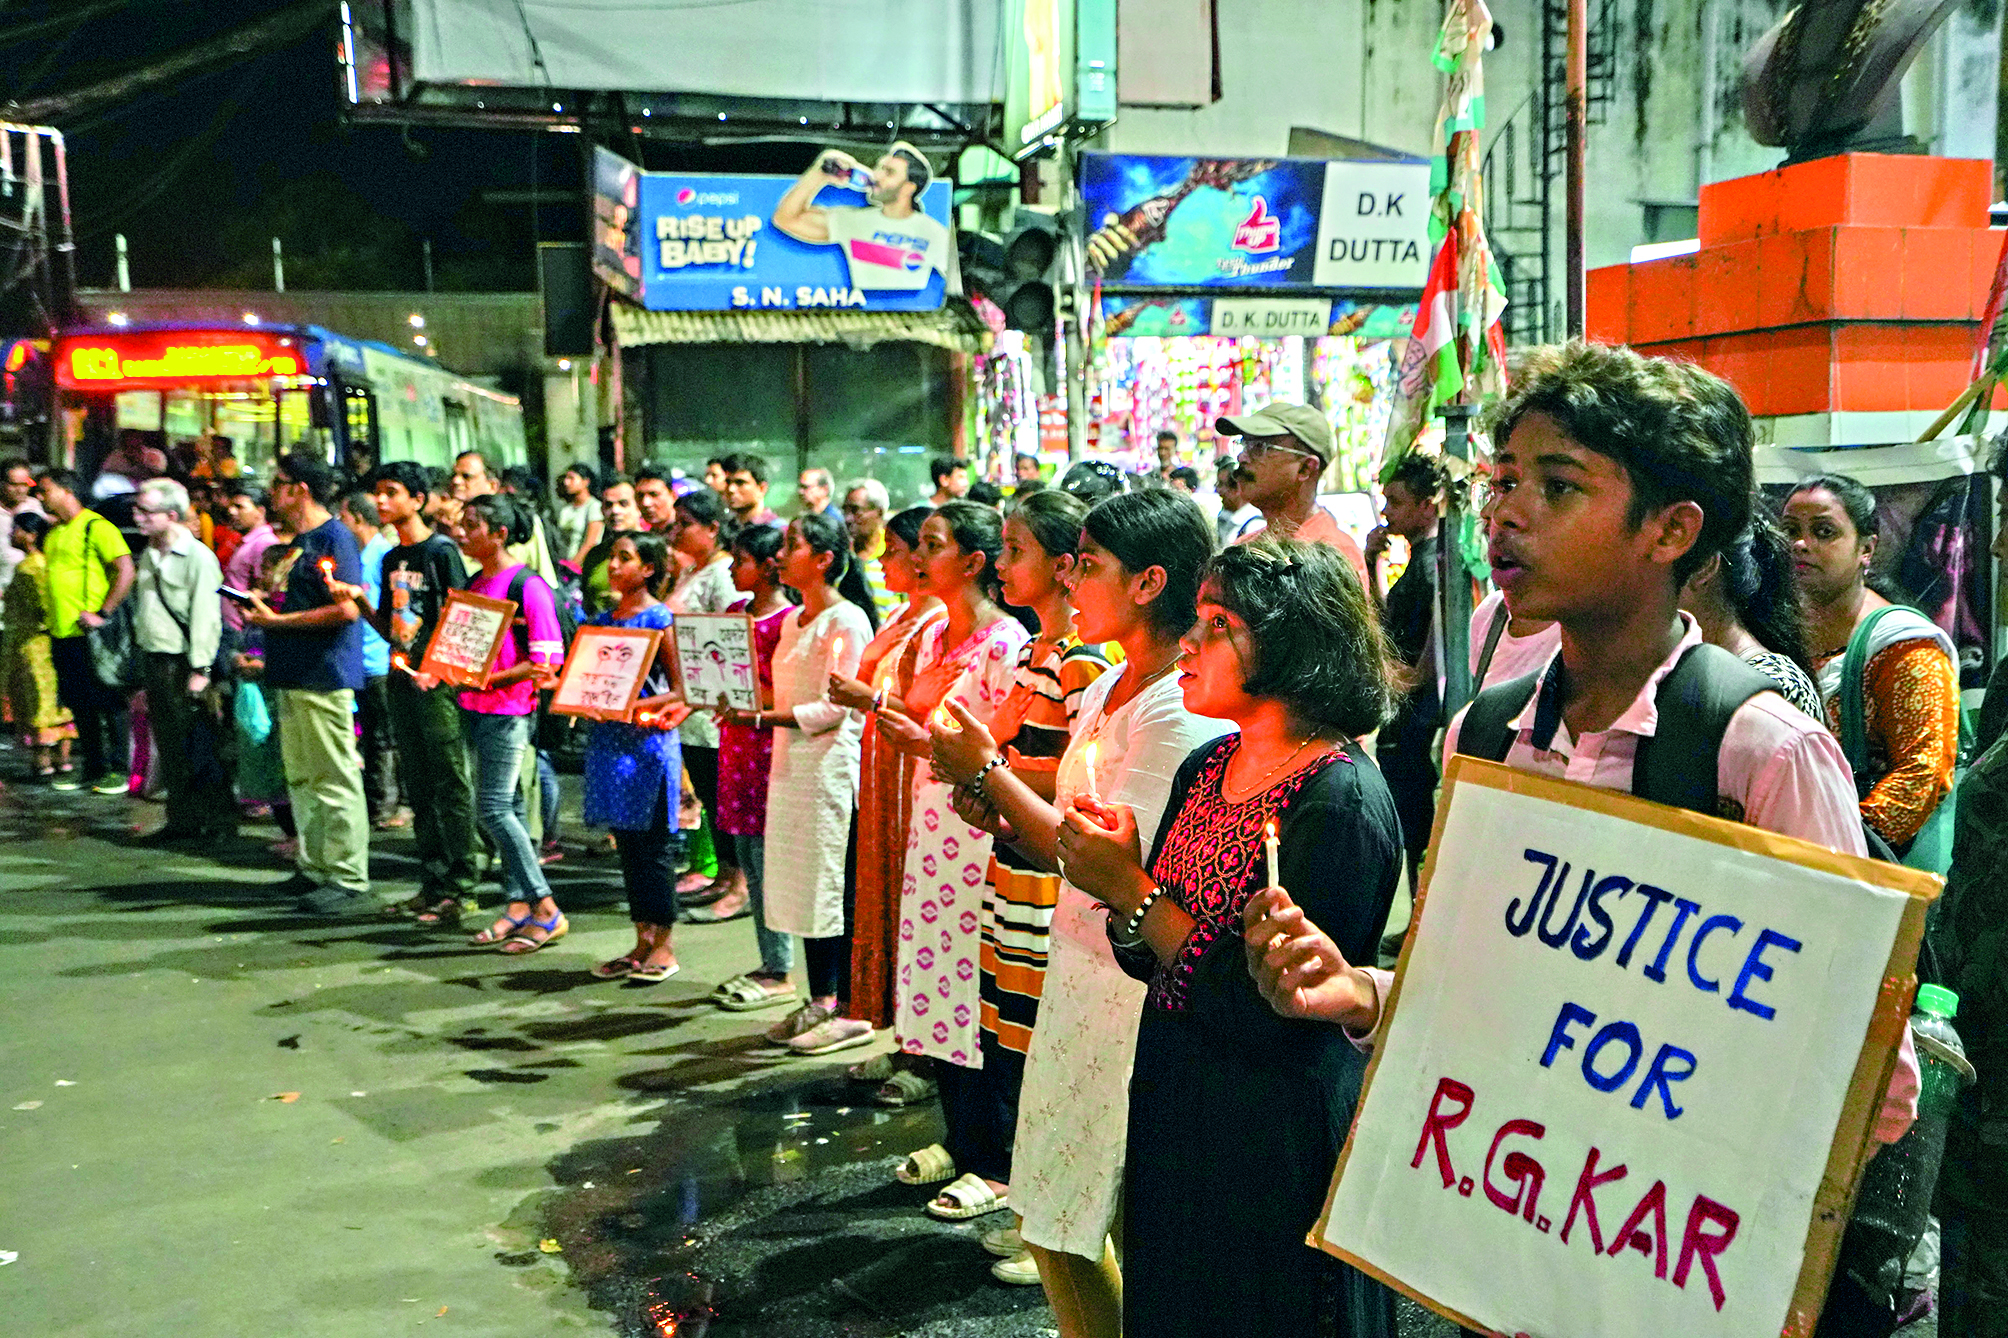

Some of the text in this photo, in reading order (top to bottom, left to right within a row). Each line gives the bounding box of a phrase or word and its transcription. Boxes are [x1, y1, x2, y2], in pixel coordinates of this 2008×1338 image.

[1357, 193, 1406, 217] D.K
[656, 215, 763, 240] RISE UP
[872, 230, 930, 252] PEPSI
[1330, 238, 1420, 263] DUTTA
[660, 239, 758, 269] BABY!
[732, 286, 867, 307] S. N. SAHA
[1222, 311, 1321, 328] D. K. DUTTA
[1505, 848, 1803, 1021] JUSTICE
[1540, 1002, 1698, 1120] FOR
[1410, 1077, 1741, 1313] R.G.KAR
